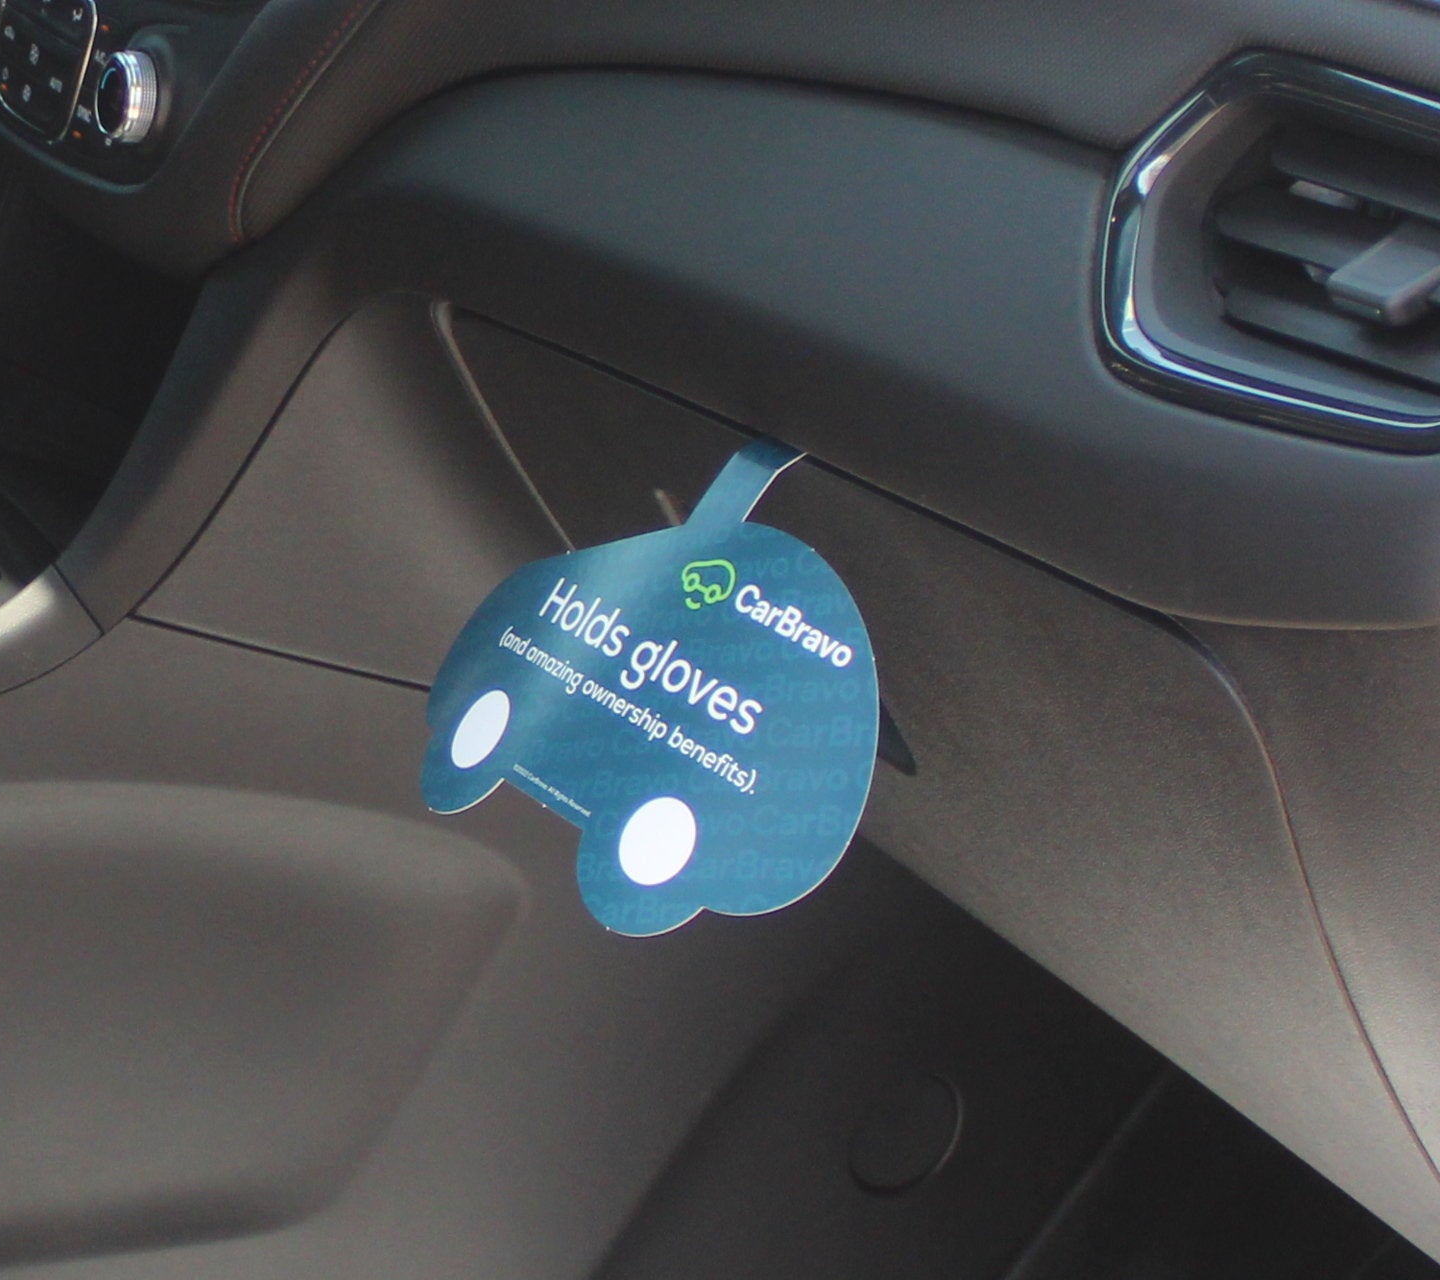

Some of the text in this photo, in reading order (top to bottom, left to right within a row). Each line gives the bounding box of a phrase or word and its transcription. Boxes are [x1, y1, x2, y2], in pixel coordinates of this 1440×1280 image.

[539, 577, 764, 735] Holds gloves
[734, 583, 853, 668] CarBravo
[499, 626, 532, 655] (and
[526, 646, 585, 695] amazing
[582, 679, 668, 741] ownership
[667, 725, 757, 795] benefits).
